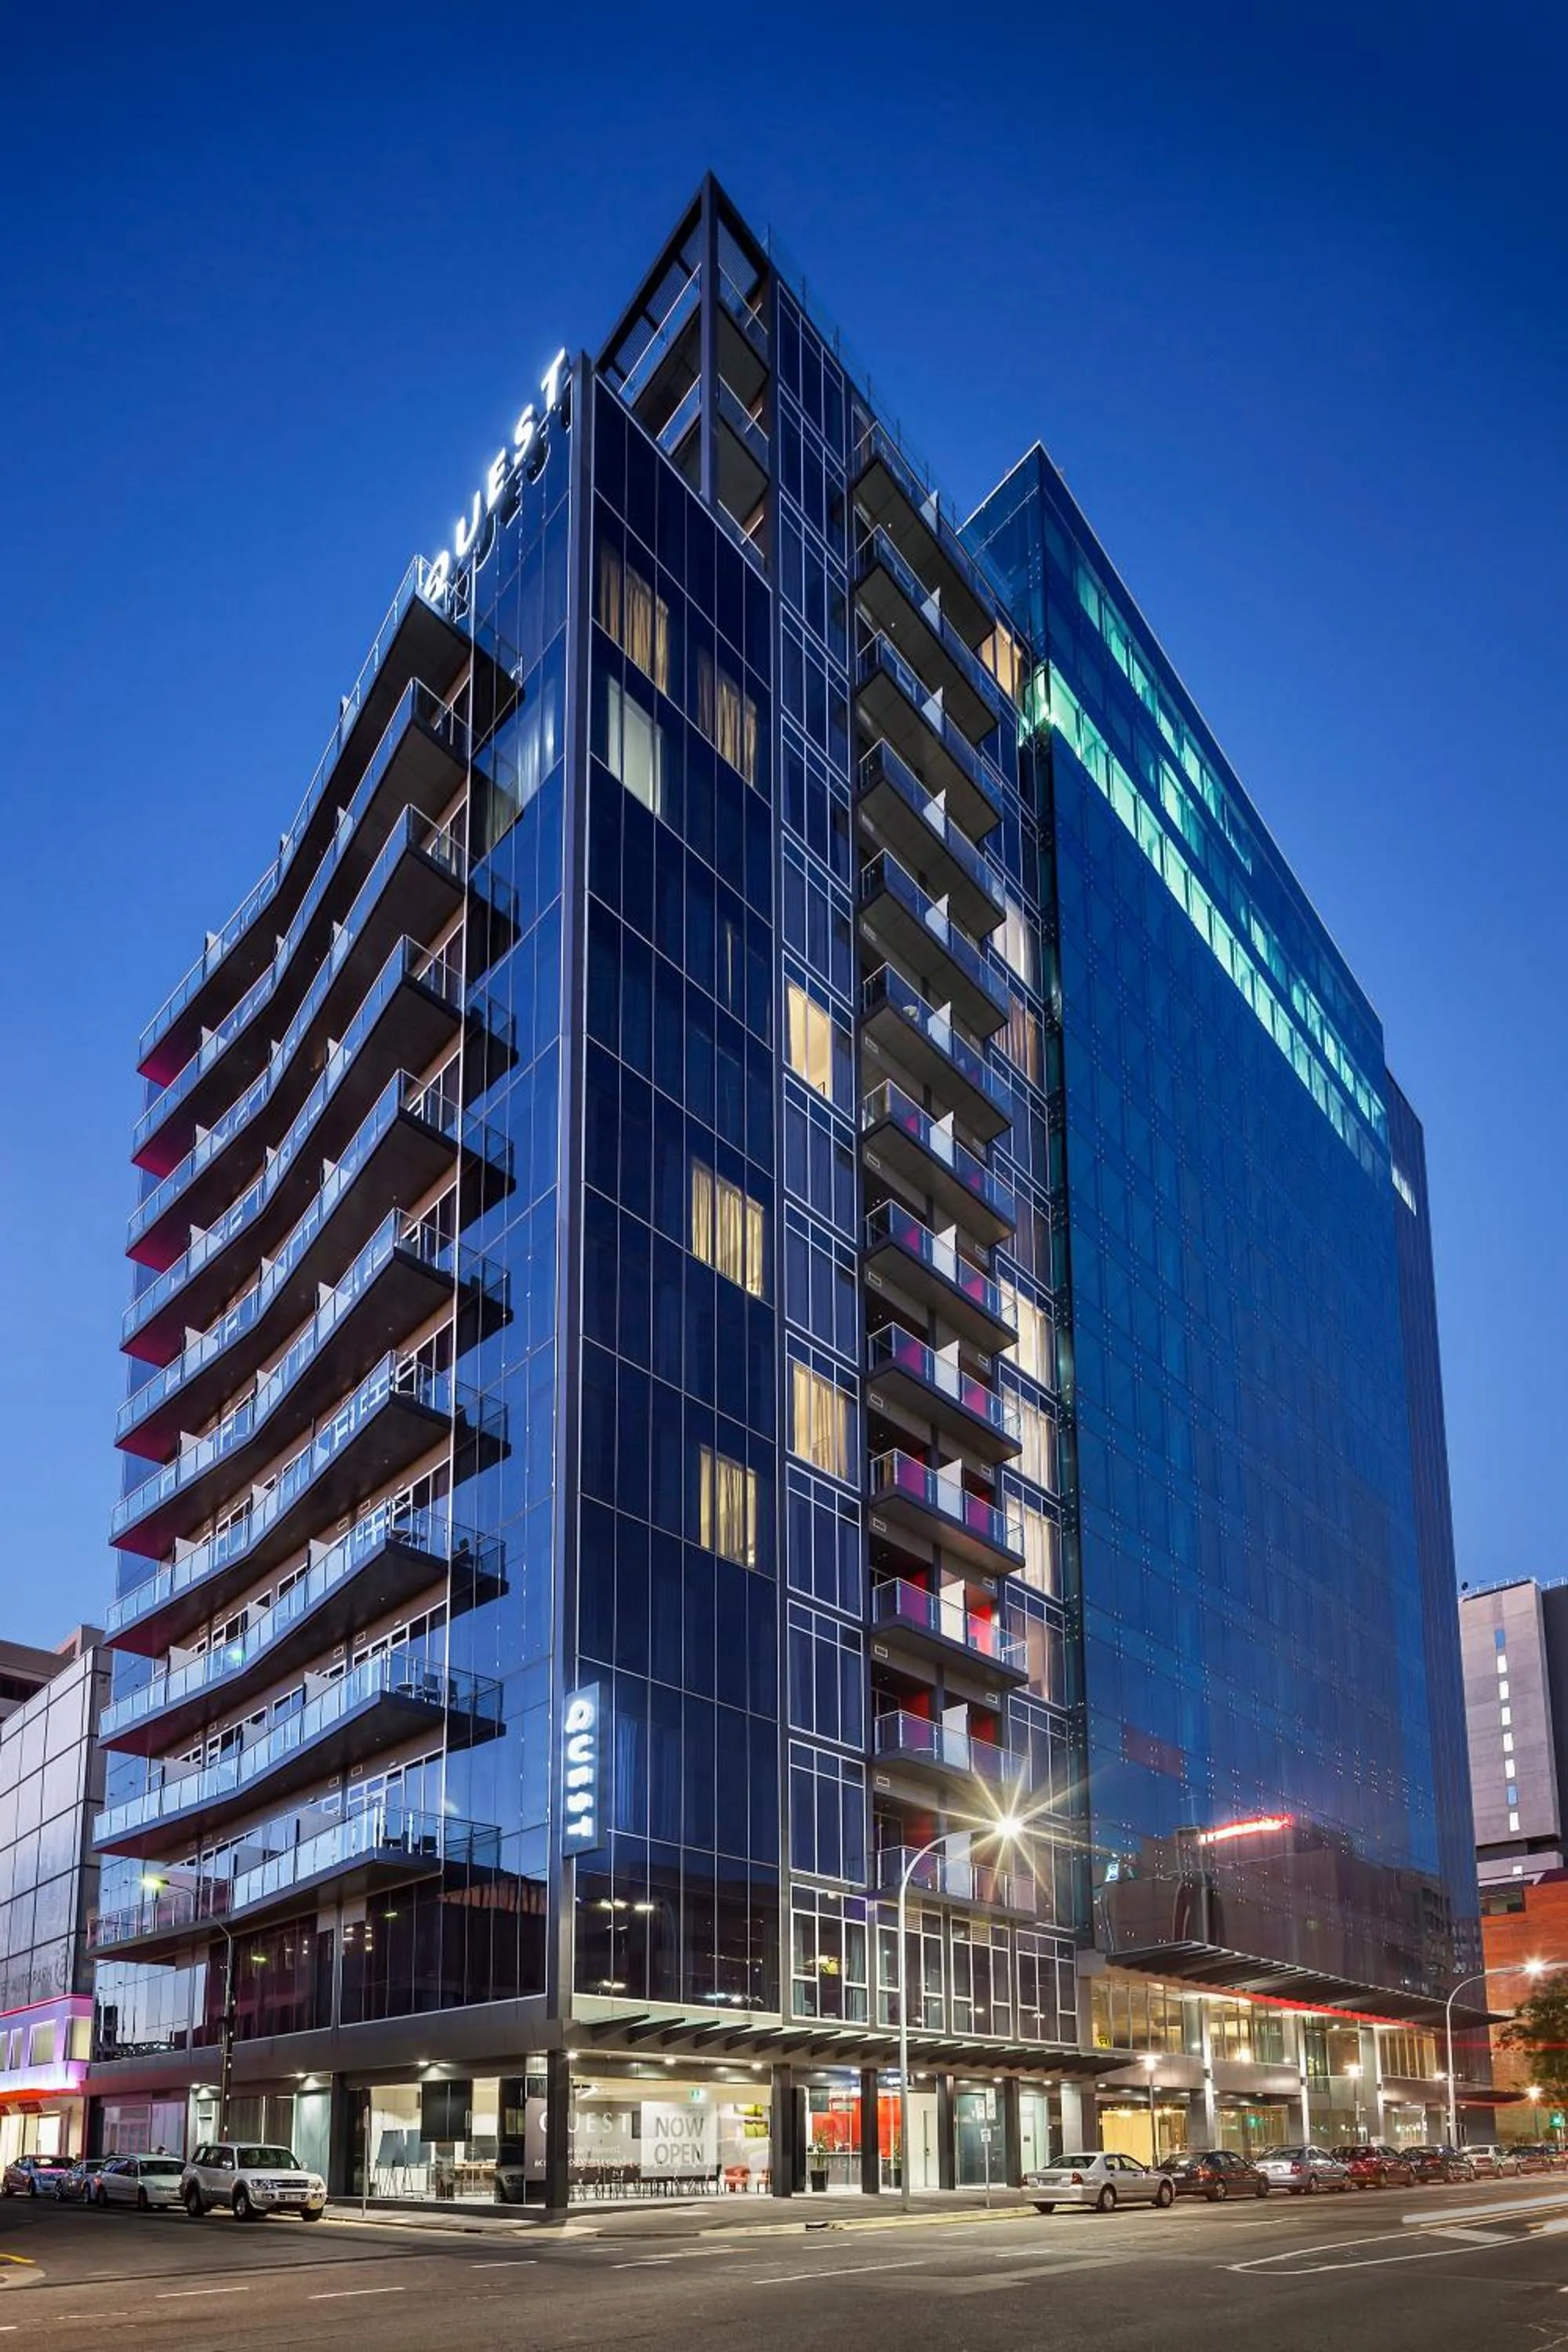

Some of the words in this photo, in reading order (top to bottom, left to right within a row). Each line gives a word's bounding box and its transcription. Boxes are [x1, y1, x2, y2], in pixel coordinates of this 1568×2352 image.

[424, 347, 566, 603] QUEST
[655, 2117, 704, 2138] NOW
[654, 2143, 704, 2164] OPEN
